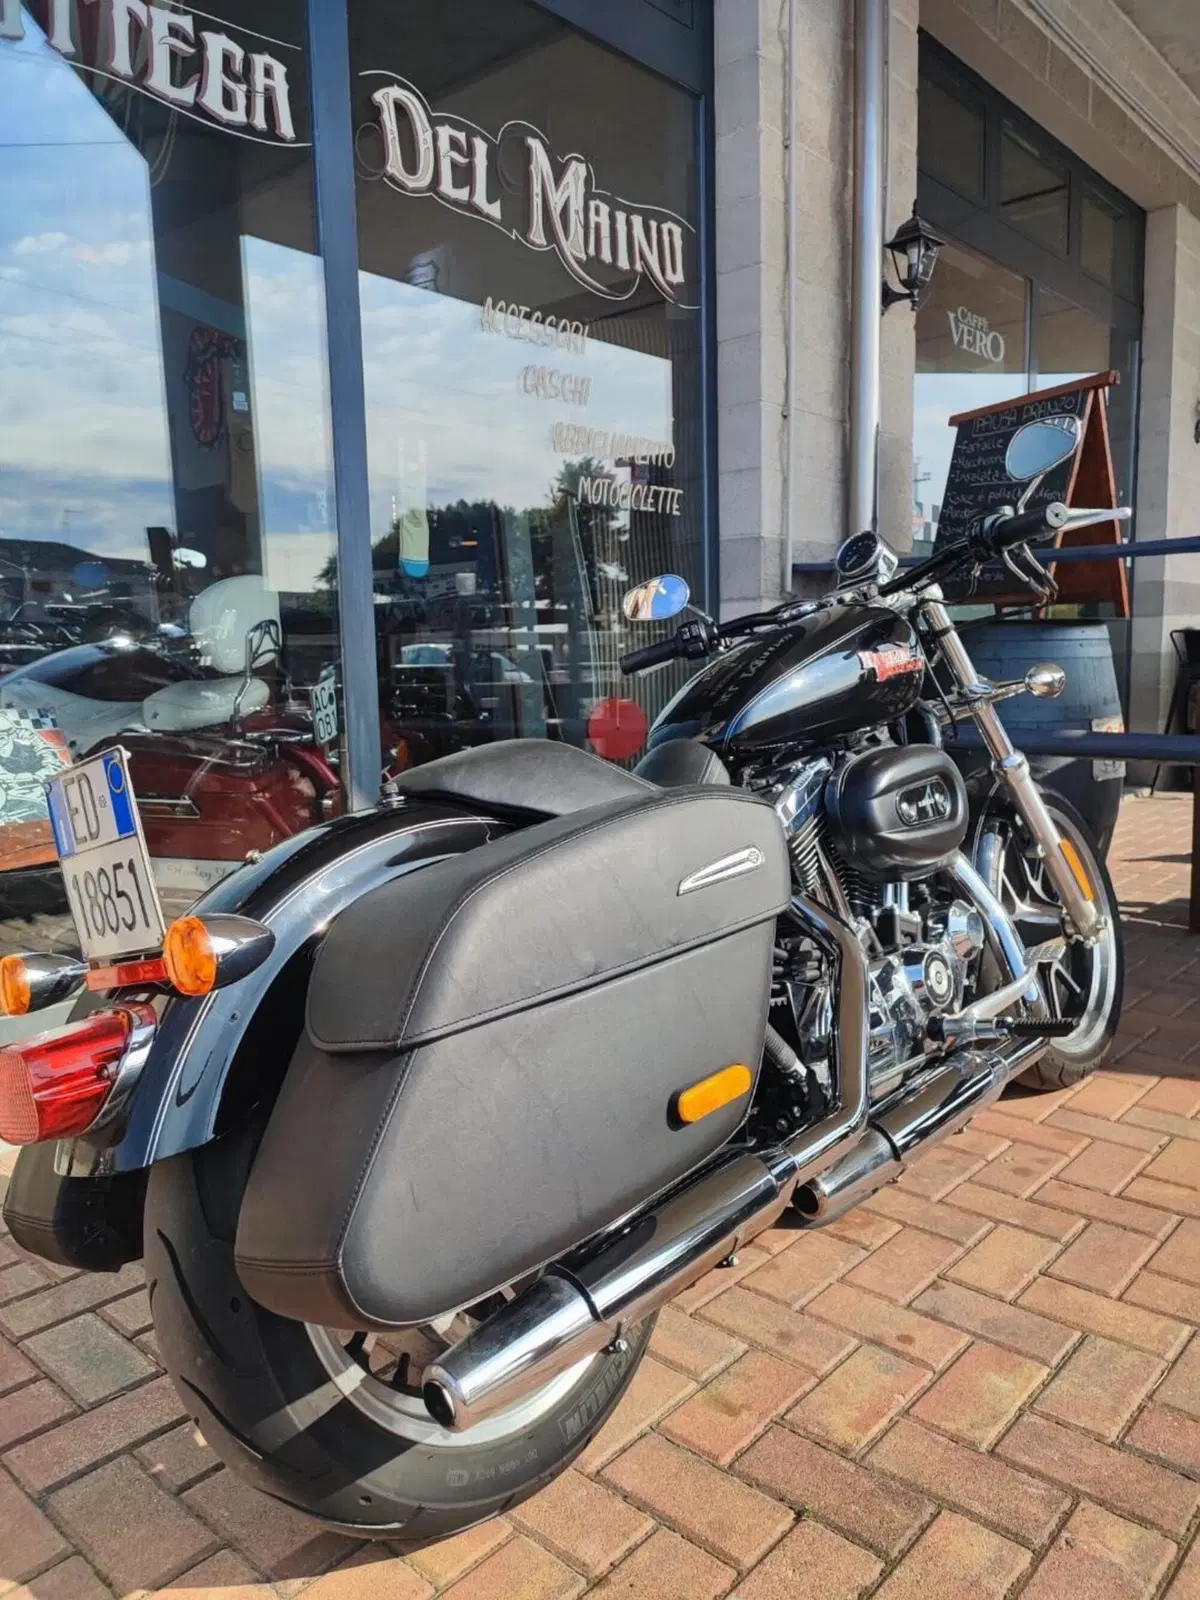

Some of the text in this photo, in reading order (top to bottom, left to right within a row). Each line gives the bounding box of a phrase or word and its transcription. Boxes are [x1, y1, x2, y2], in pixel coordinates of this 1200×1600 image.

[0, 0, 296, 141] TTEGA
[371, 85, 684, 302] DEL MAINO
[947, 310, 1005, 362] VERO
[574, 475, 683, 516] MOTOCICLETTE
[62, 771, 101, 845] ED
[72, 858, 150, 940] 18851
